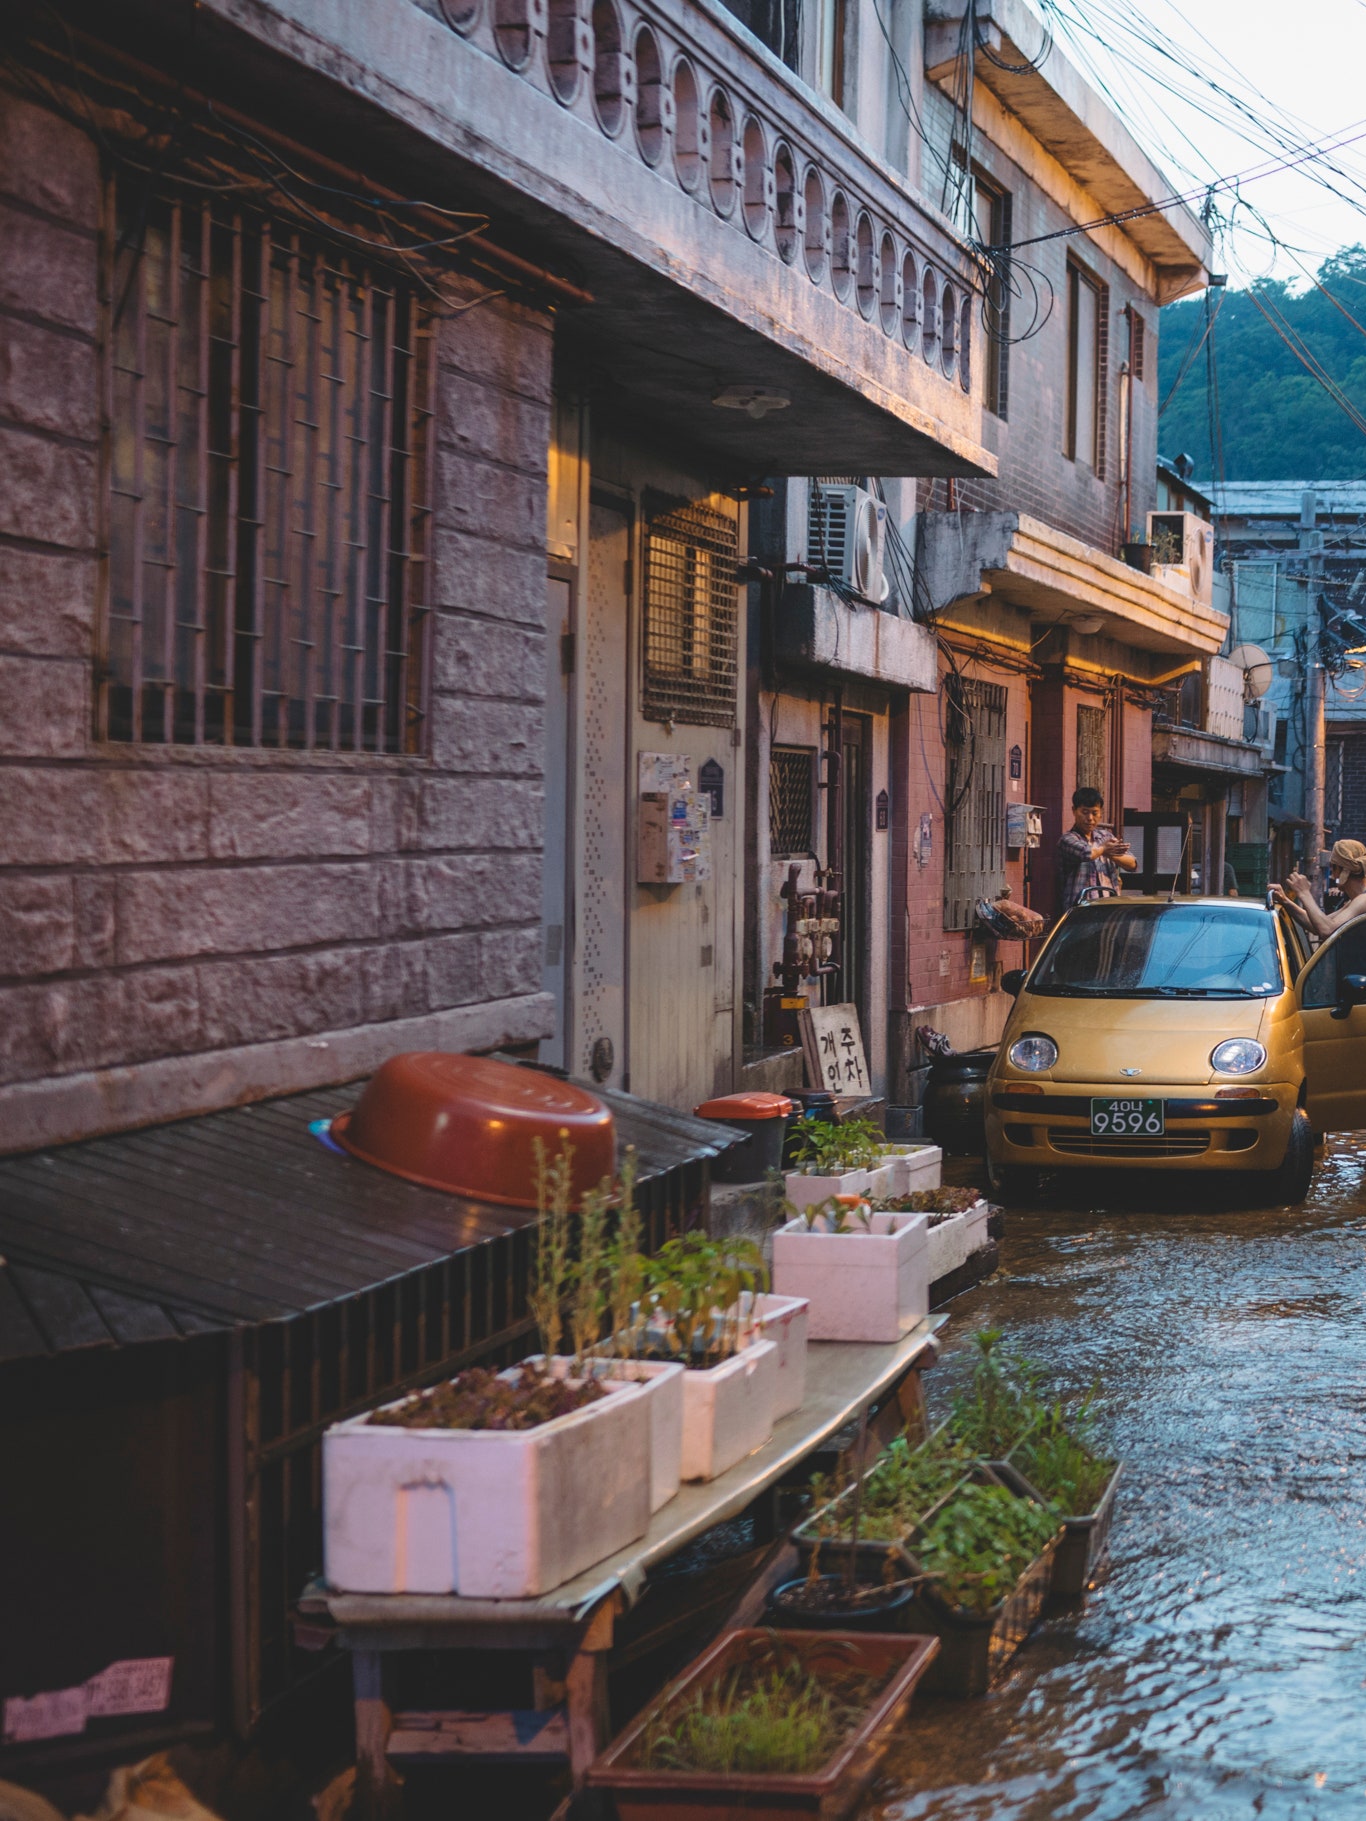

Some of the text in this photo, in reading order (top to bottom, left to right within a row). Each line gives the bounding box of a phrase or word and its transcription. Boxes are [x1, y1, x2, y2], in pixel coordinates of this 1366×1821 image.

[820, 1030, 842, 1094] 개인
[840, 1027, 863, 1089] 주차
[1094, 1112, 1161, 1133] 9596
[1108, 1100, 1144, 1112] 40나
